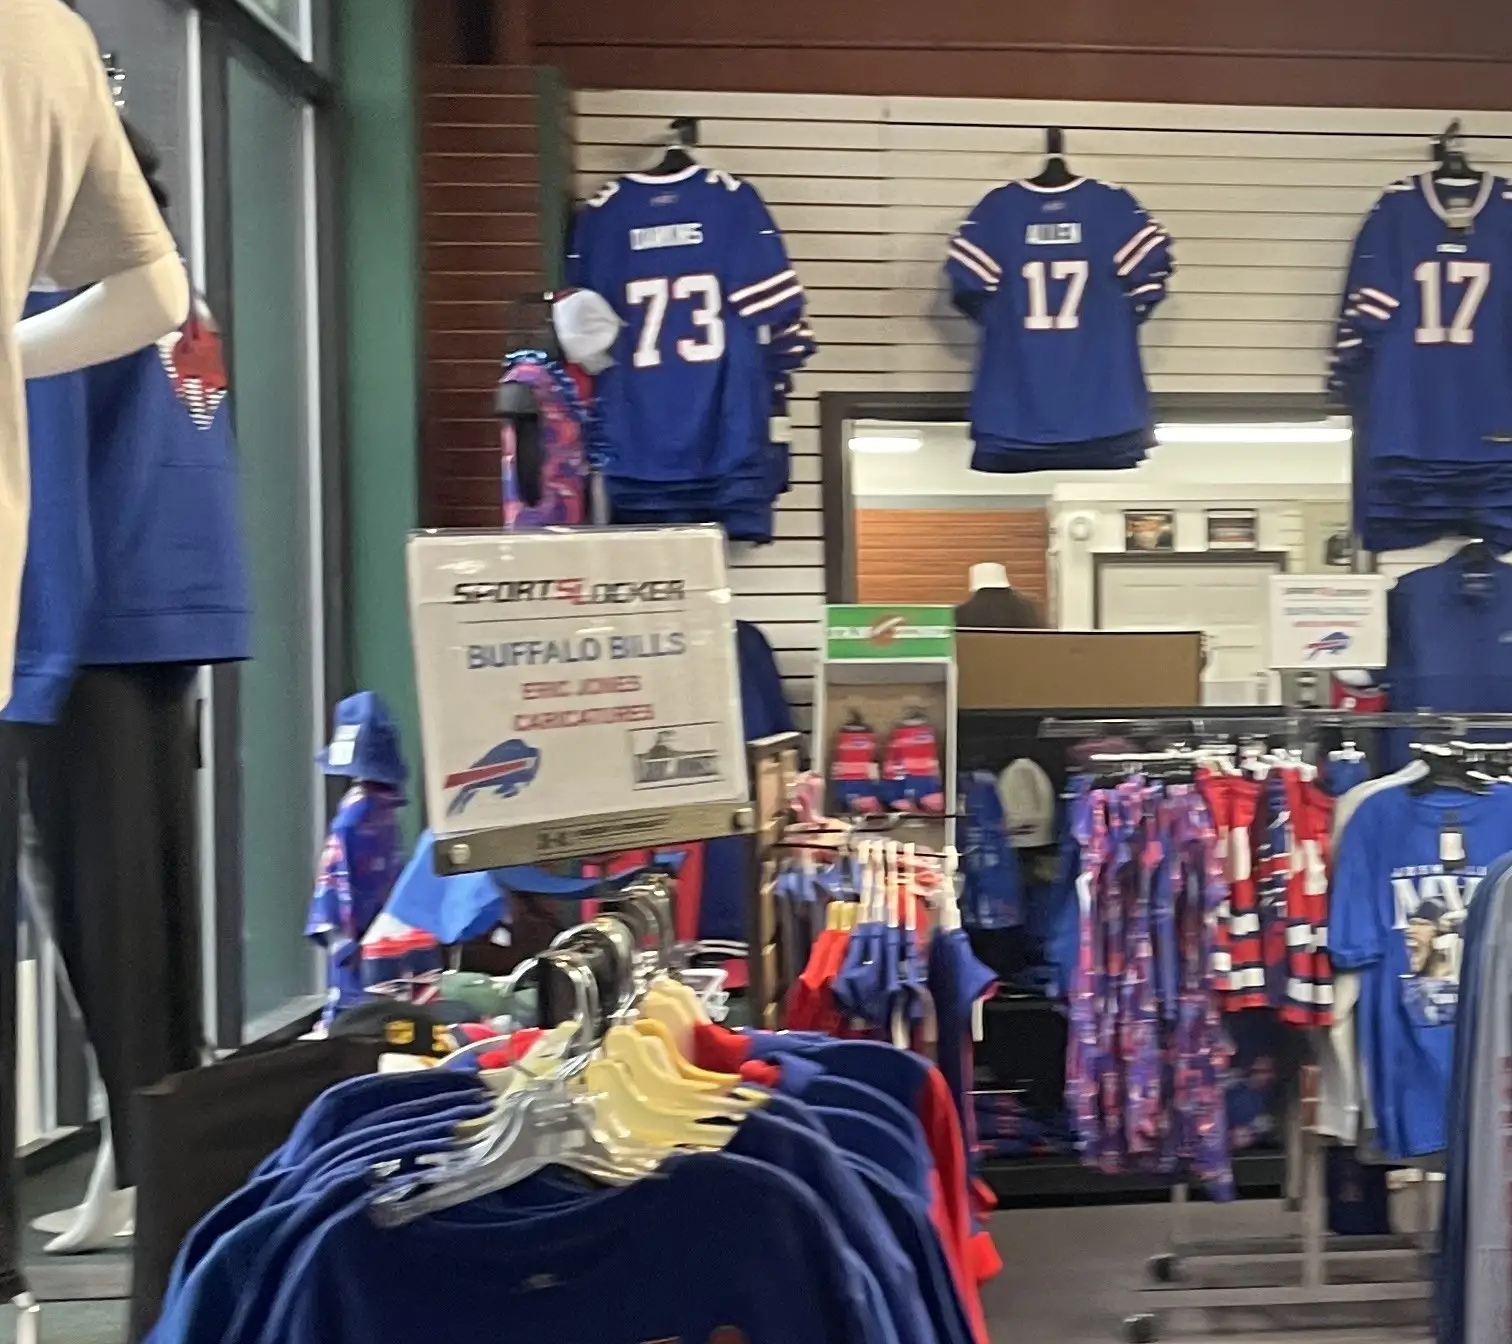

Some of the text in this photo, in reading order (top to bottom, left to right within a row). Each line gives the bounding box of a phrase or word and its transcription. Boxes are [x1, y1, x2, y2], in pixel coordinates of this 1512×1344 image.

[626, 273, 726, 368] 73
[1022, 260, 1090, 330] 17
[1413, 260, 1491, 344] 17
[467, 632, 688, 670] BUFFALO BILLS
